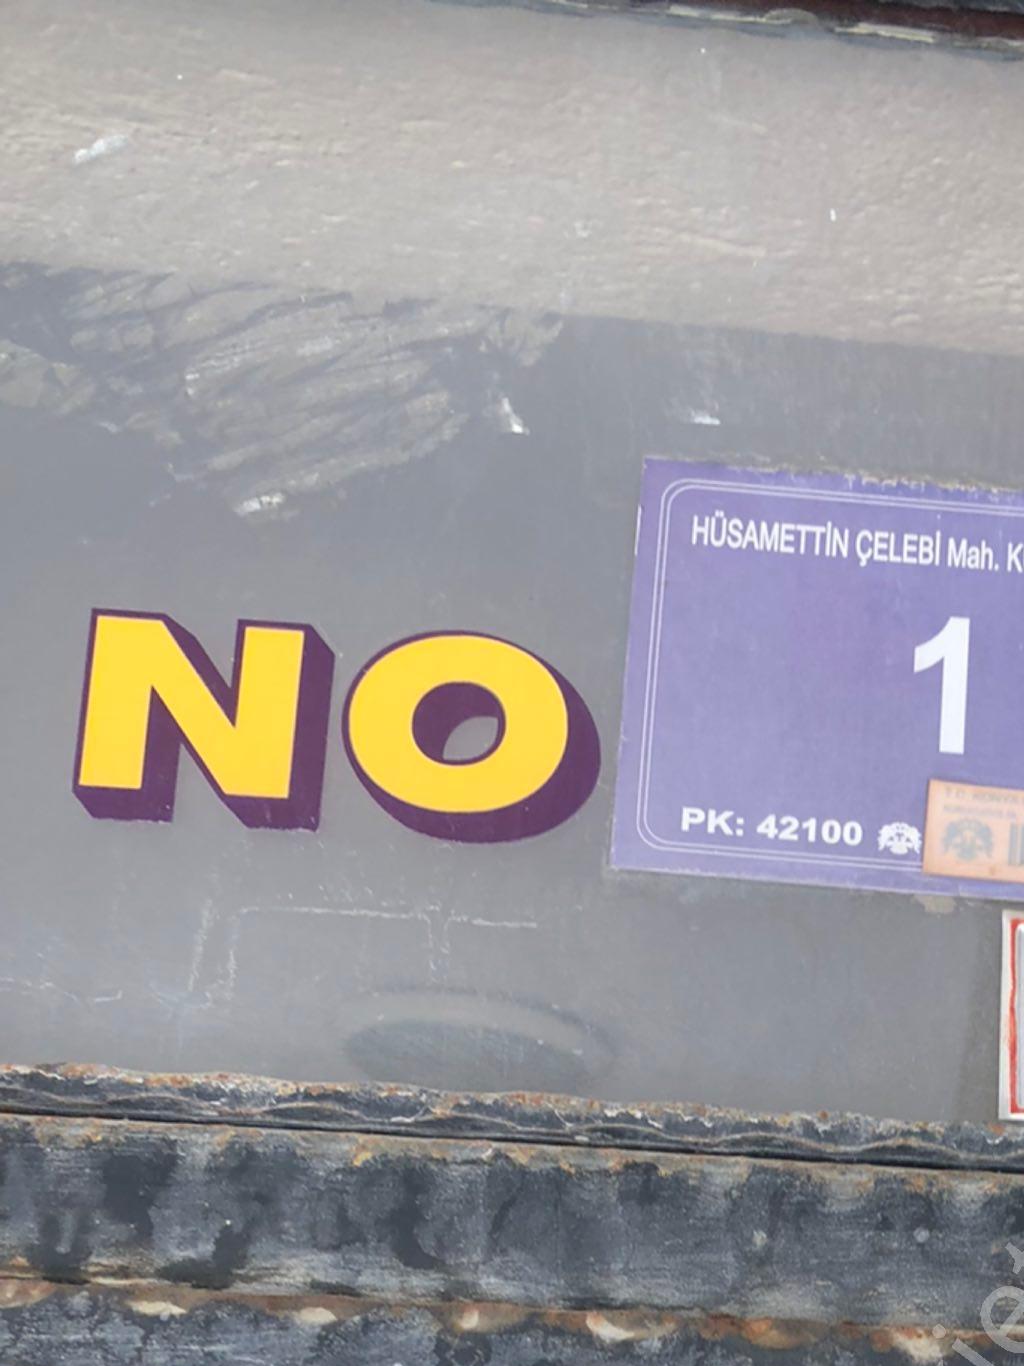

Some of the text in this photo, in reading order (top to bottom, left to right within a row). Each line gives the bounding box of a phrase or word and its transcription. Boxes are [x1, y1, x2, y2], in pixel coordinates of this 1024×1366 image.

[691, 515, 849, 559] HÜSAMETTİN
[855, 530, 940, 567] ÇELEBİ
[947, 537, 1000, 571] Mah.
[74, 609, 600, 842] NO
[913, 616, 970, 754] 1
[681, 806, 863, 846] PK: 42100
